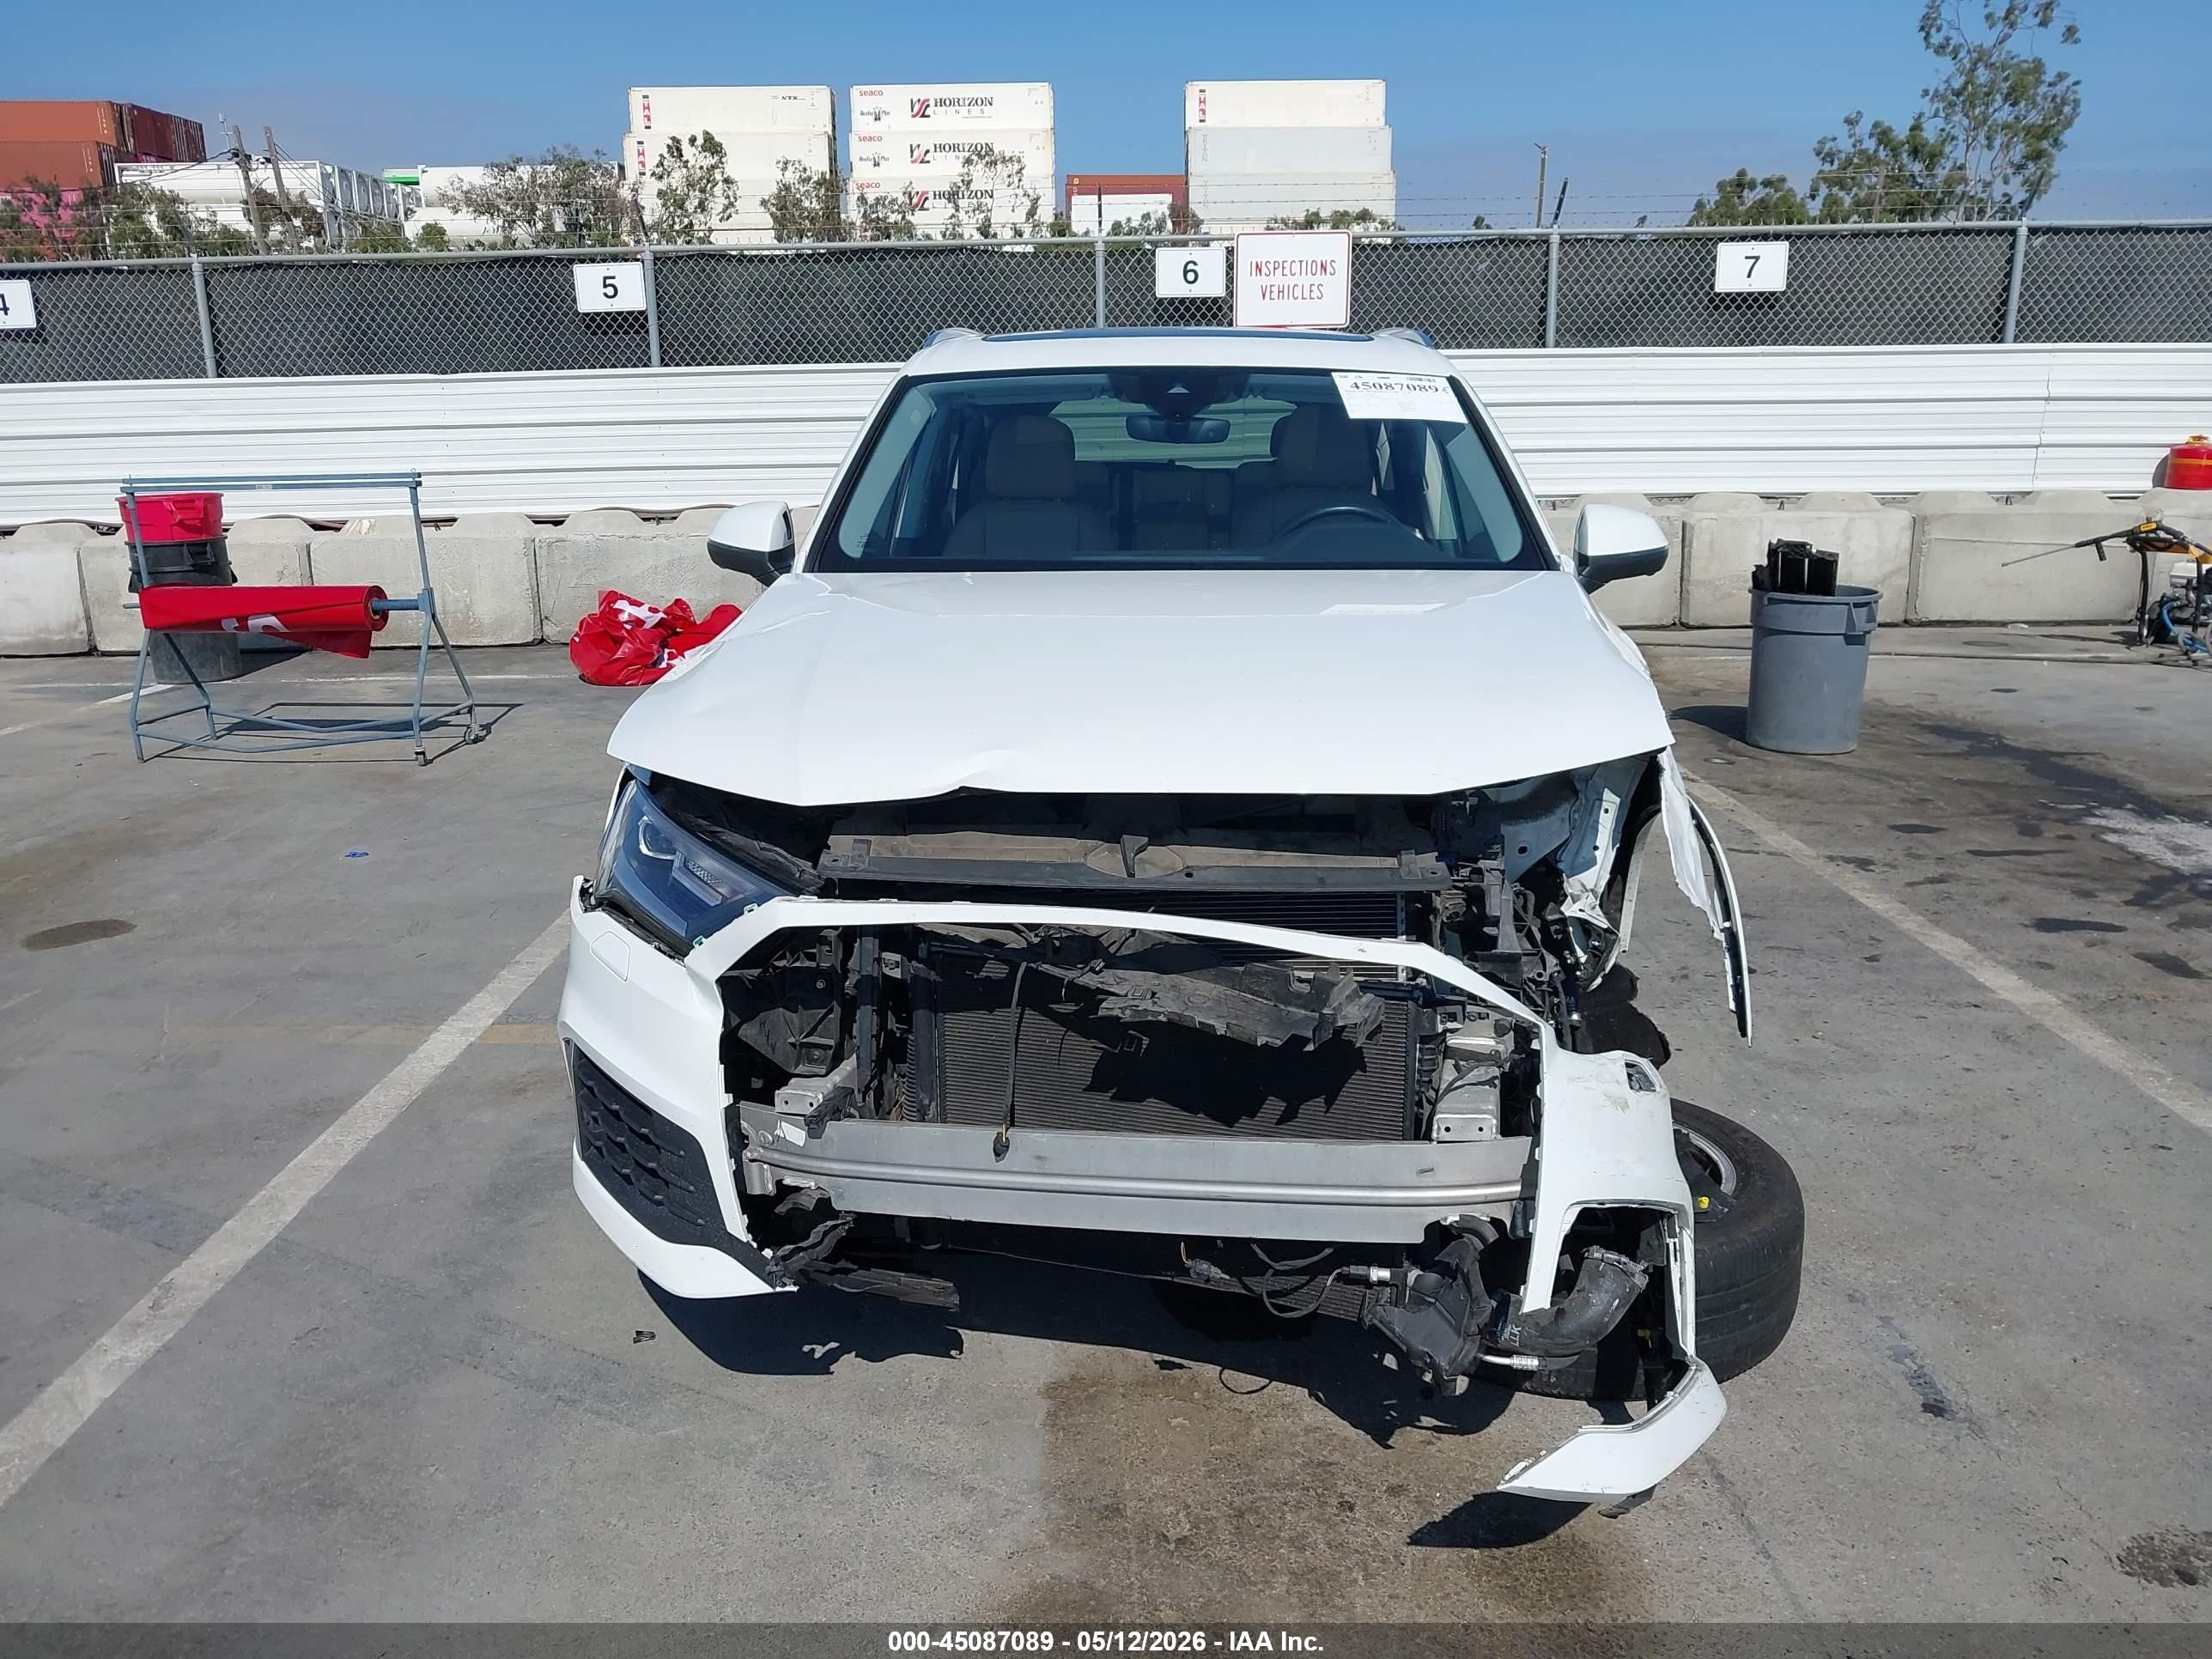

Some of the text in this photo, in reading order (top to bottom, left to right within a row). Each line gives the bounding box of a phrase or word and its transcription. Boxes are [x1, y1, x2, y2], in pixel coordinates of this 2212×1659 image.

[933, 96, 994, 107] HORIZON
[933, 143, 994, 153] HORIZON
[1182, 260, 1199, 284] 6
[1249, 260, 1336, 277] INSPECTIONS
[1745, 255, 1760, 278] 7
[603, 276, 618, 299] 5
[1261, 283, 1324, 301] VEHICLES
[1350, 382, 1439, 393] 45087089
